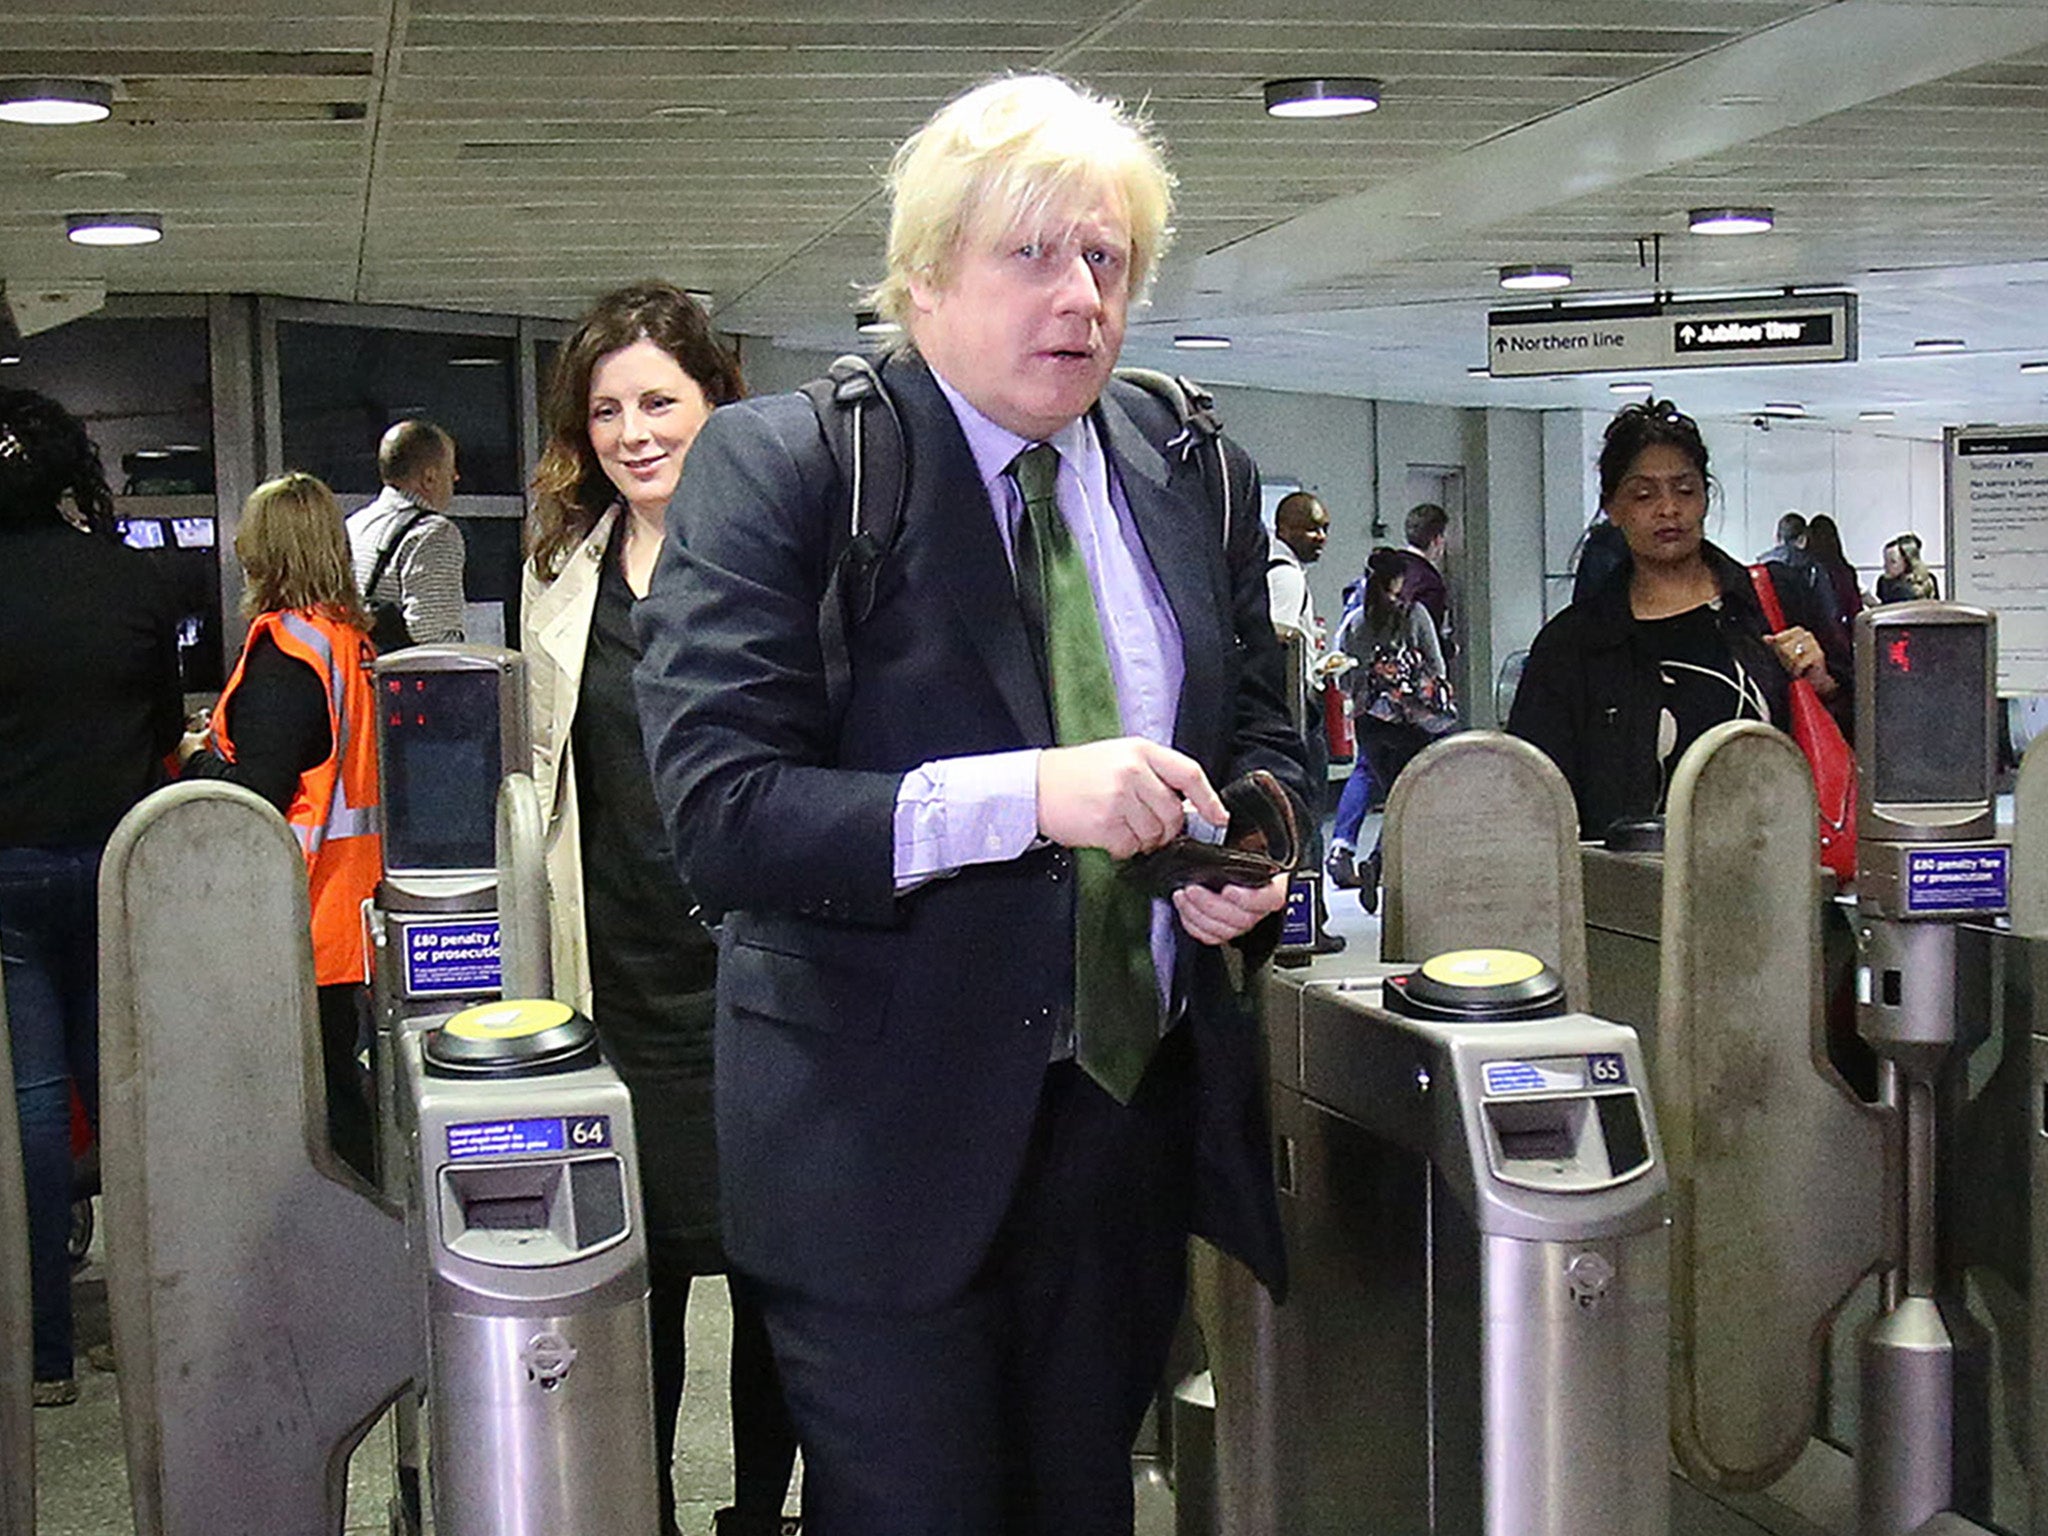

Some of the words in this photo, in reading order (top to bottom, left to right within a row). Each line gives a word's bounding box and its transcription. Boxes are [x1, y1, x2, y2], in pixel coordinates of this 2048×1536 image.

[1511, 334, 1588, 351] Northern
[1593, 332, 1624, 346] line
[1697, 322, 1762, 343] Jubilee
[1766, 321, 1801, 340] line
[440, 932, 491, 948] penalty
[413, 951, 429, 962] or
[431, 945, 500, 963] prosecutio
[1594, 1059, 1620, 1080] 65
[573, 1122, 604, 1144] 64
